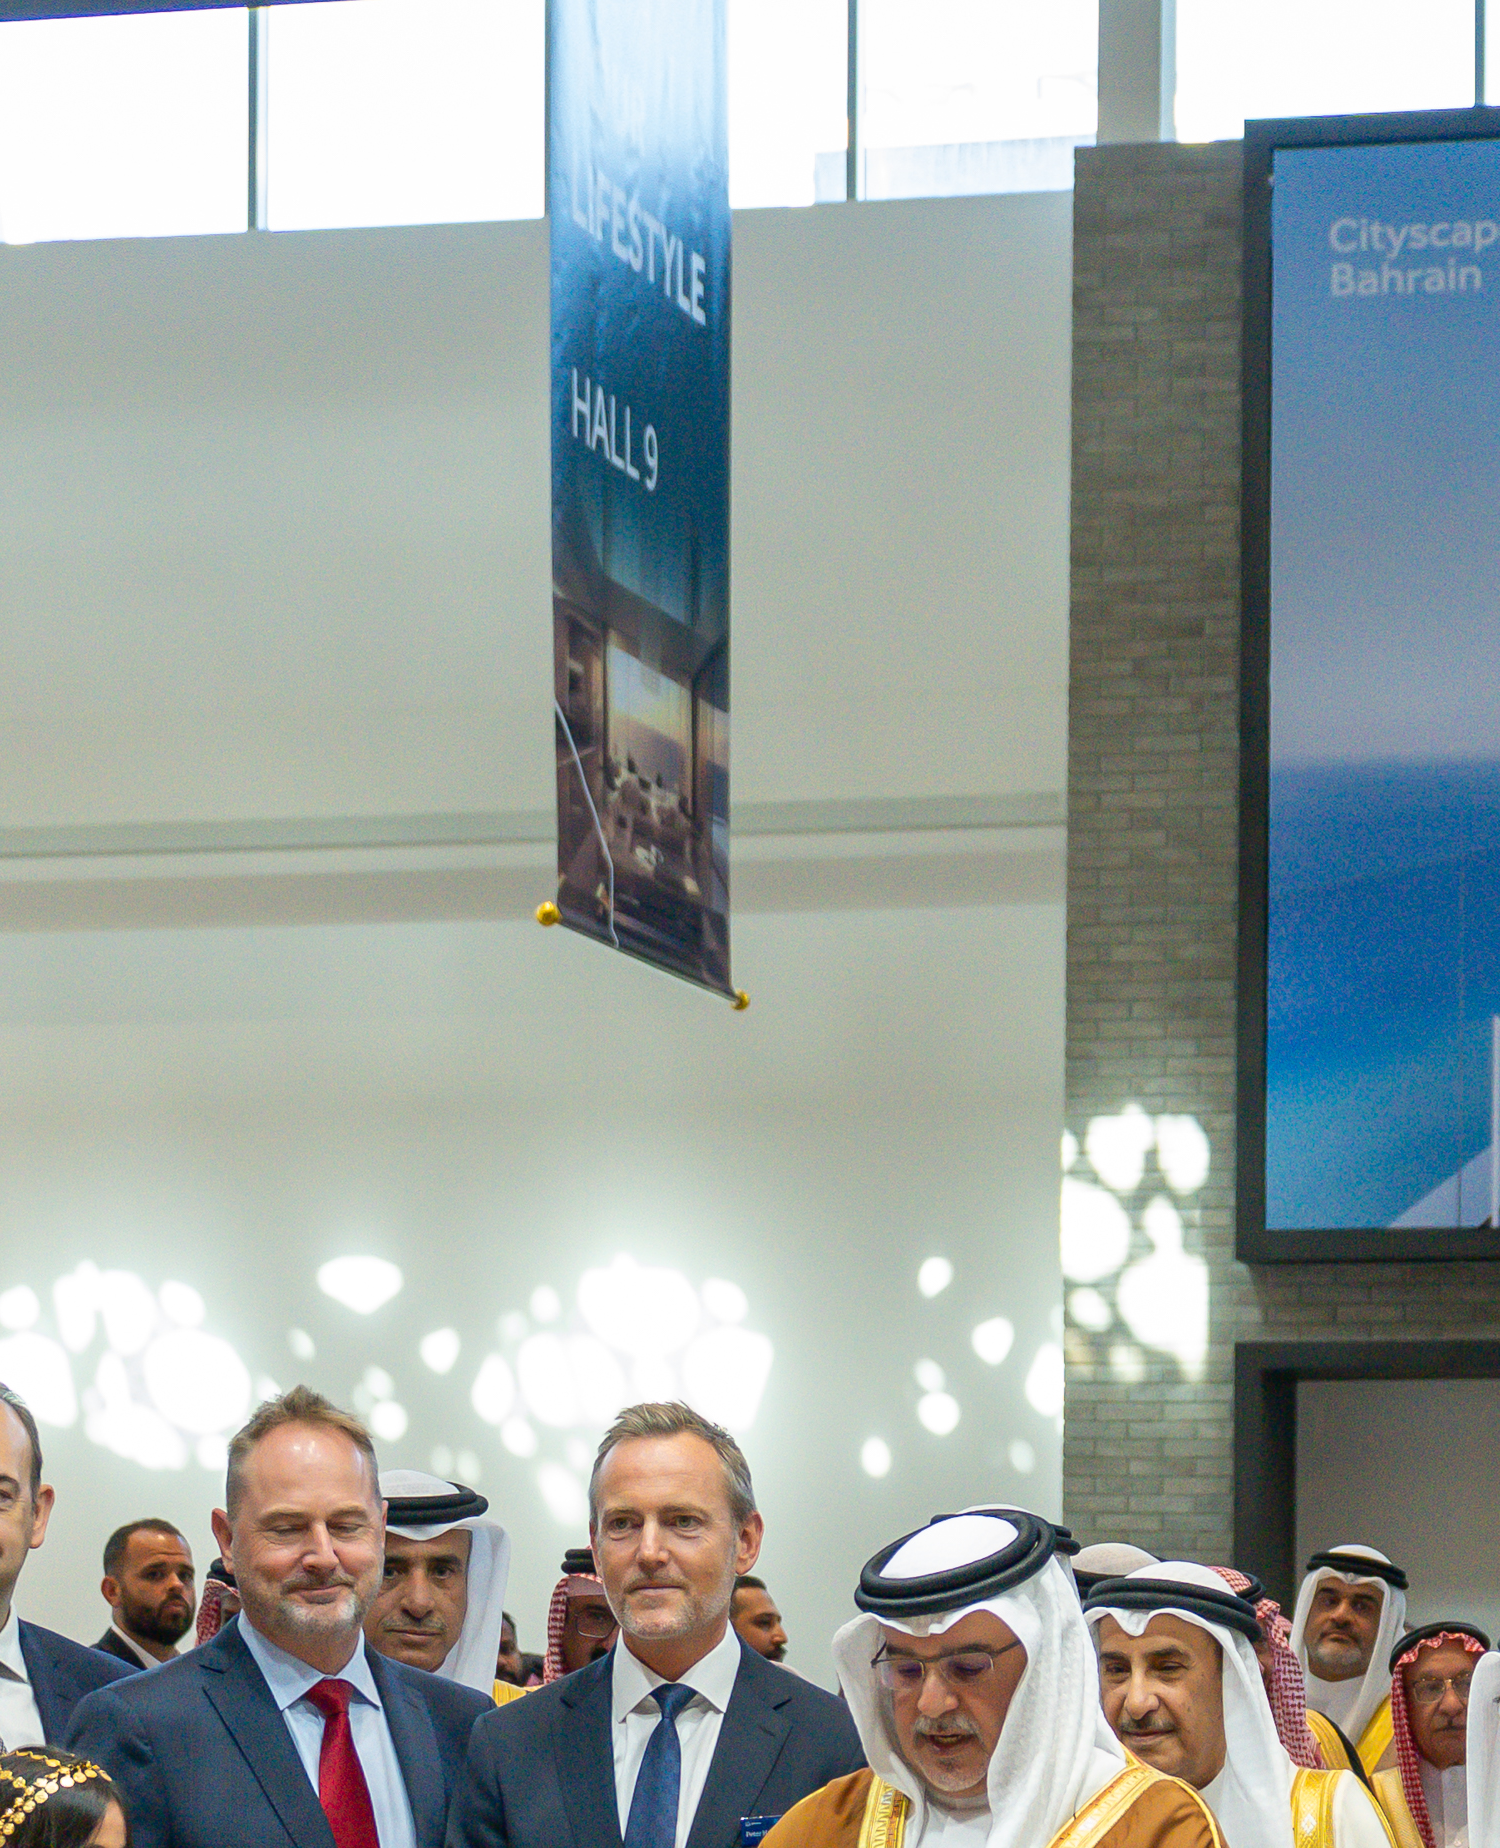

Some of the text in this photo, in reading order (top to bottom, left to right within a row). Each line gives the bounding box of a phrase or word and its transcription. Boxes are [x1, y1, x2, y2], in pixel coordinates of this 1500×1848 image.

[572, 148, 706, 326] LIFESTYLE
[1330, 257, 1483, 296] Bahrain
[572, 366, 658, 491] HALL 9
